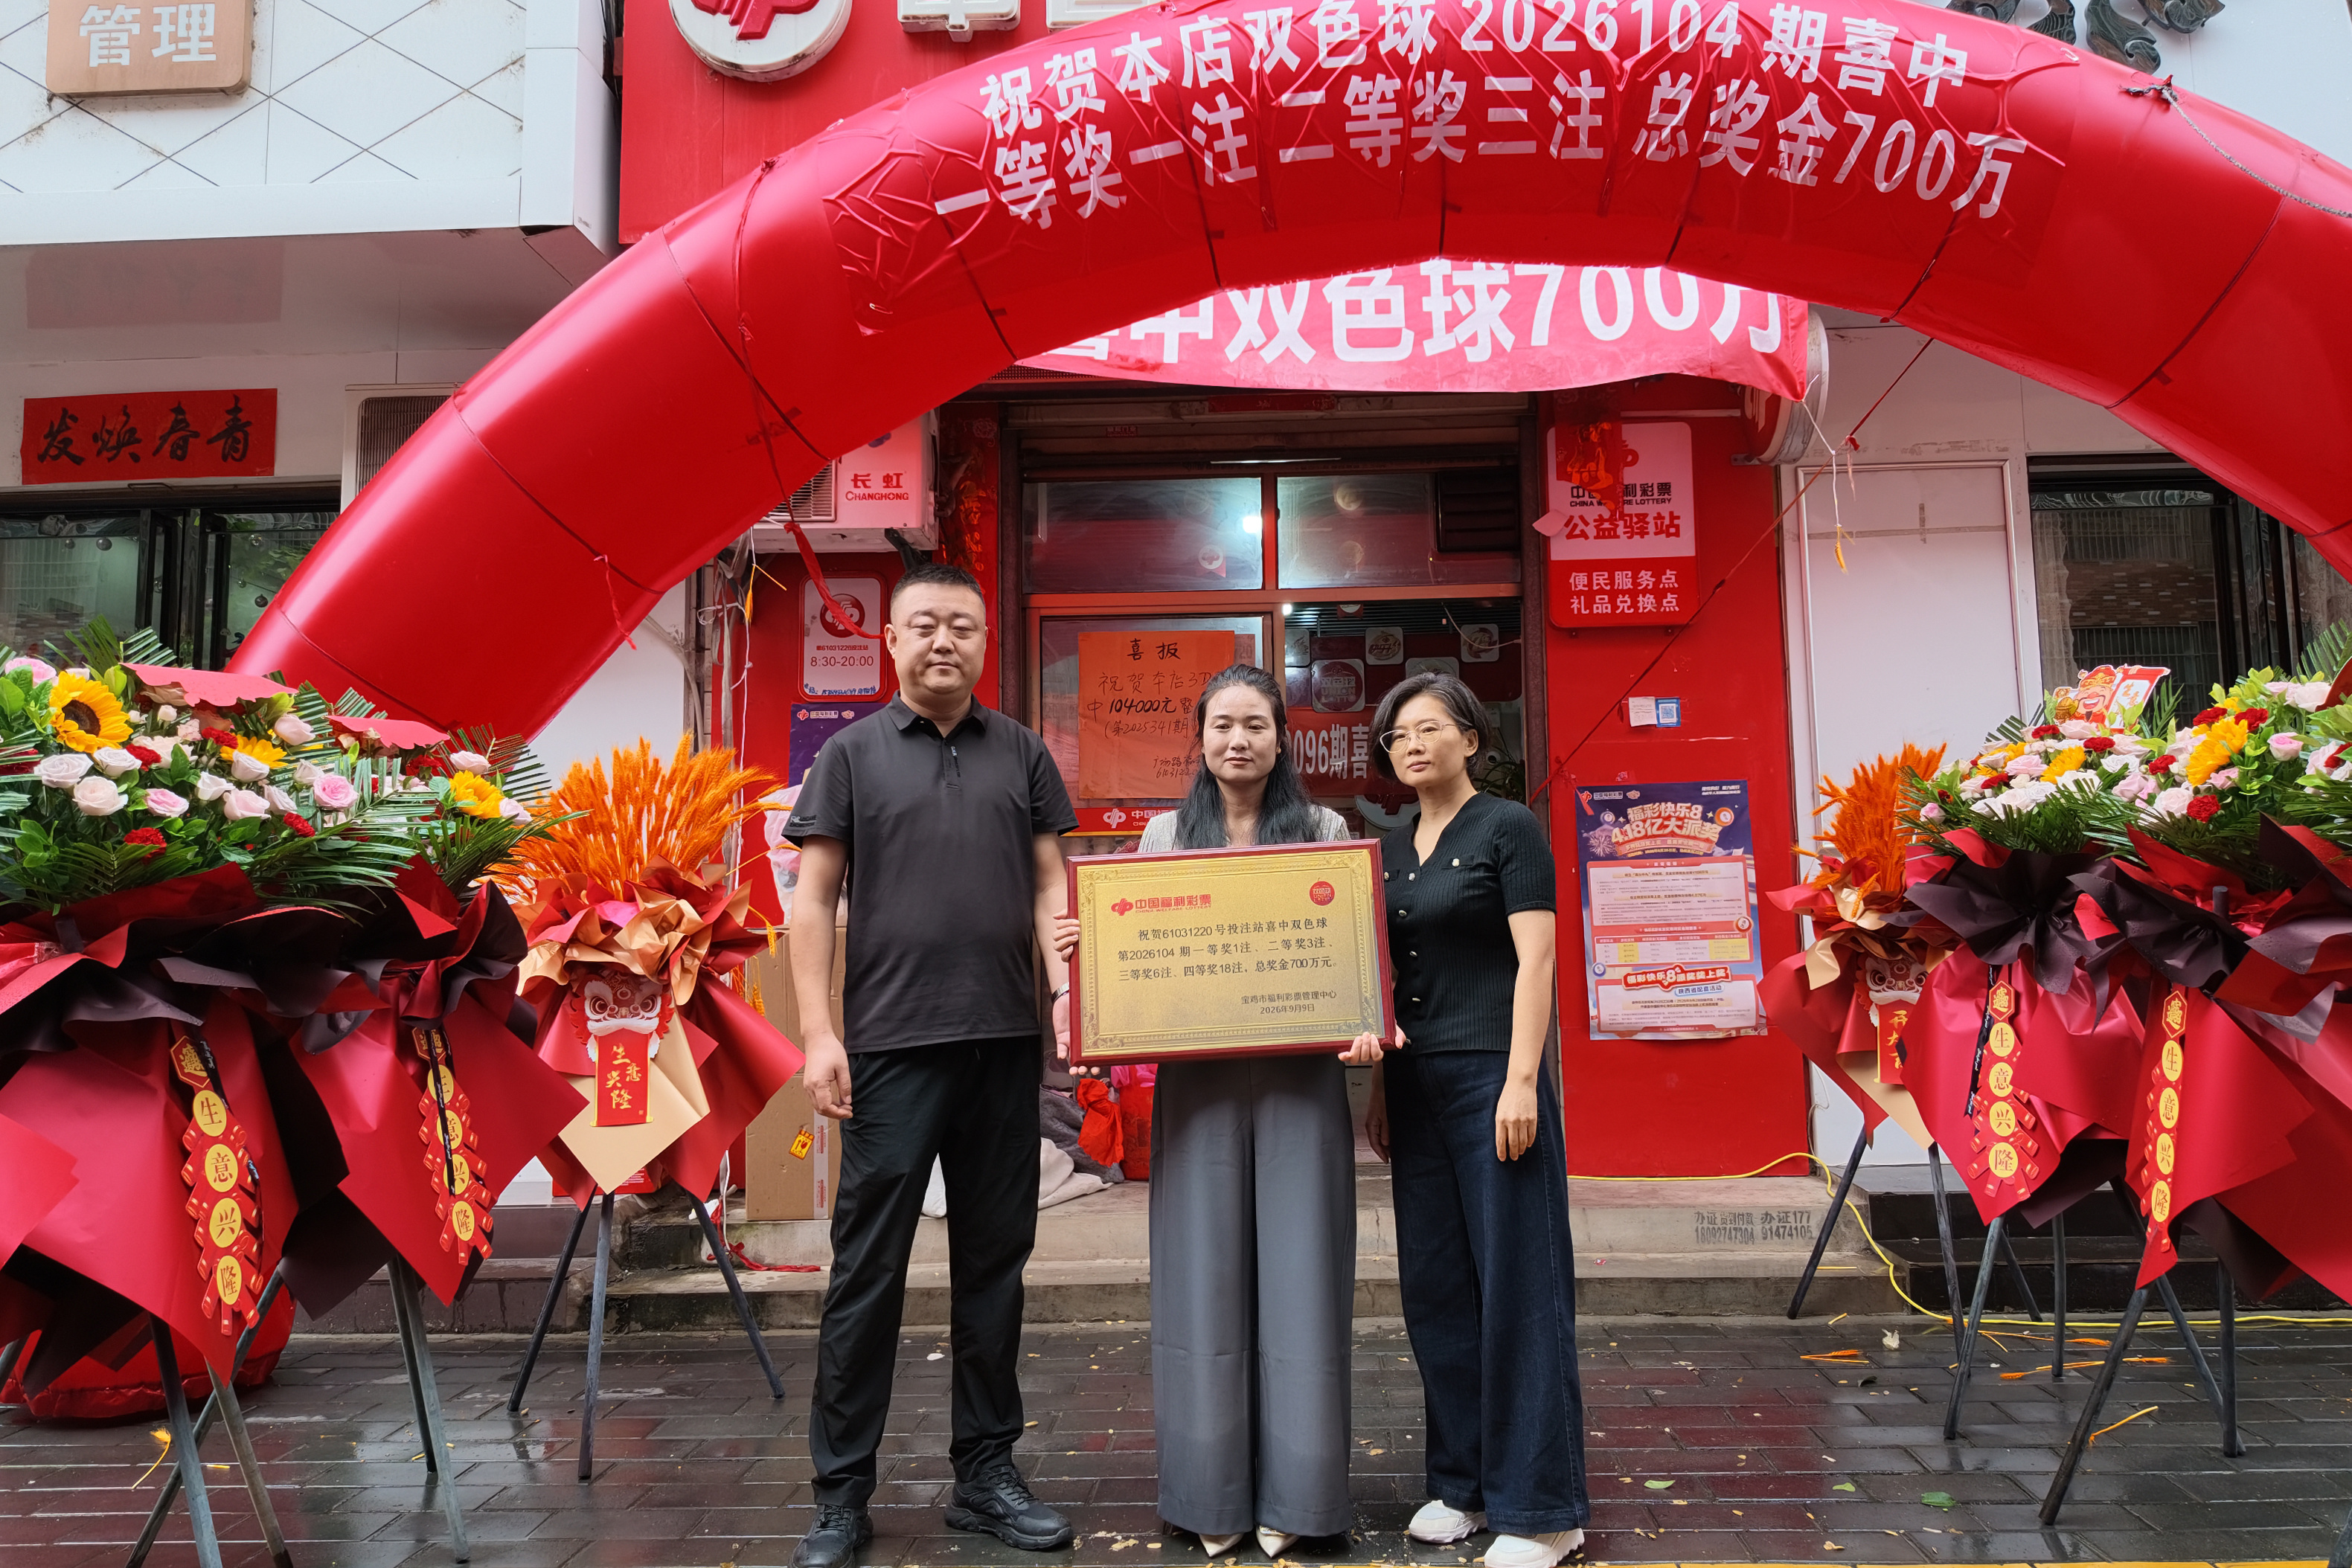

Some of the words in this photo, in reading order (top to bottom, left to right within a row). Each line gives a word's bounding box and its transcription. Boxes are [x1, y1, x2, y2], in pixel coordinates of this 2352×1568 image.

[79, 3, 217, 67] 管理
[850, 472, 903, 489] 长虹
[1571, 482, 1672, 499] 中利彩票
[845, 490, 910, 502] CHANGHONG
[1563, 511, 1681, 541] 公益驿站
[1568, 569, 1679, 592] 便民服务点
[1570, 593, 1680, 614] 礼品兑换点
[810, 656, 874, 666] 8:30-20:00
[1127, 638, 1181, 661] 喜报
[1286, 723, 1370, 779] 096期喜
[1135, 894, 1211, 909] 中国福利彩票
[1260, 1003, 1315, 1014] 2026年9月9日
[1993, 1027, 2013, 1172] 生意兴隆
[2155, 1046, 2179, 1216] 生意兴隆
[199, 1097, 239, 1297] 生意兴隆
